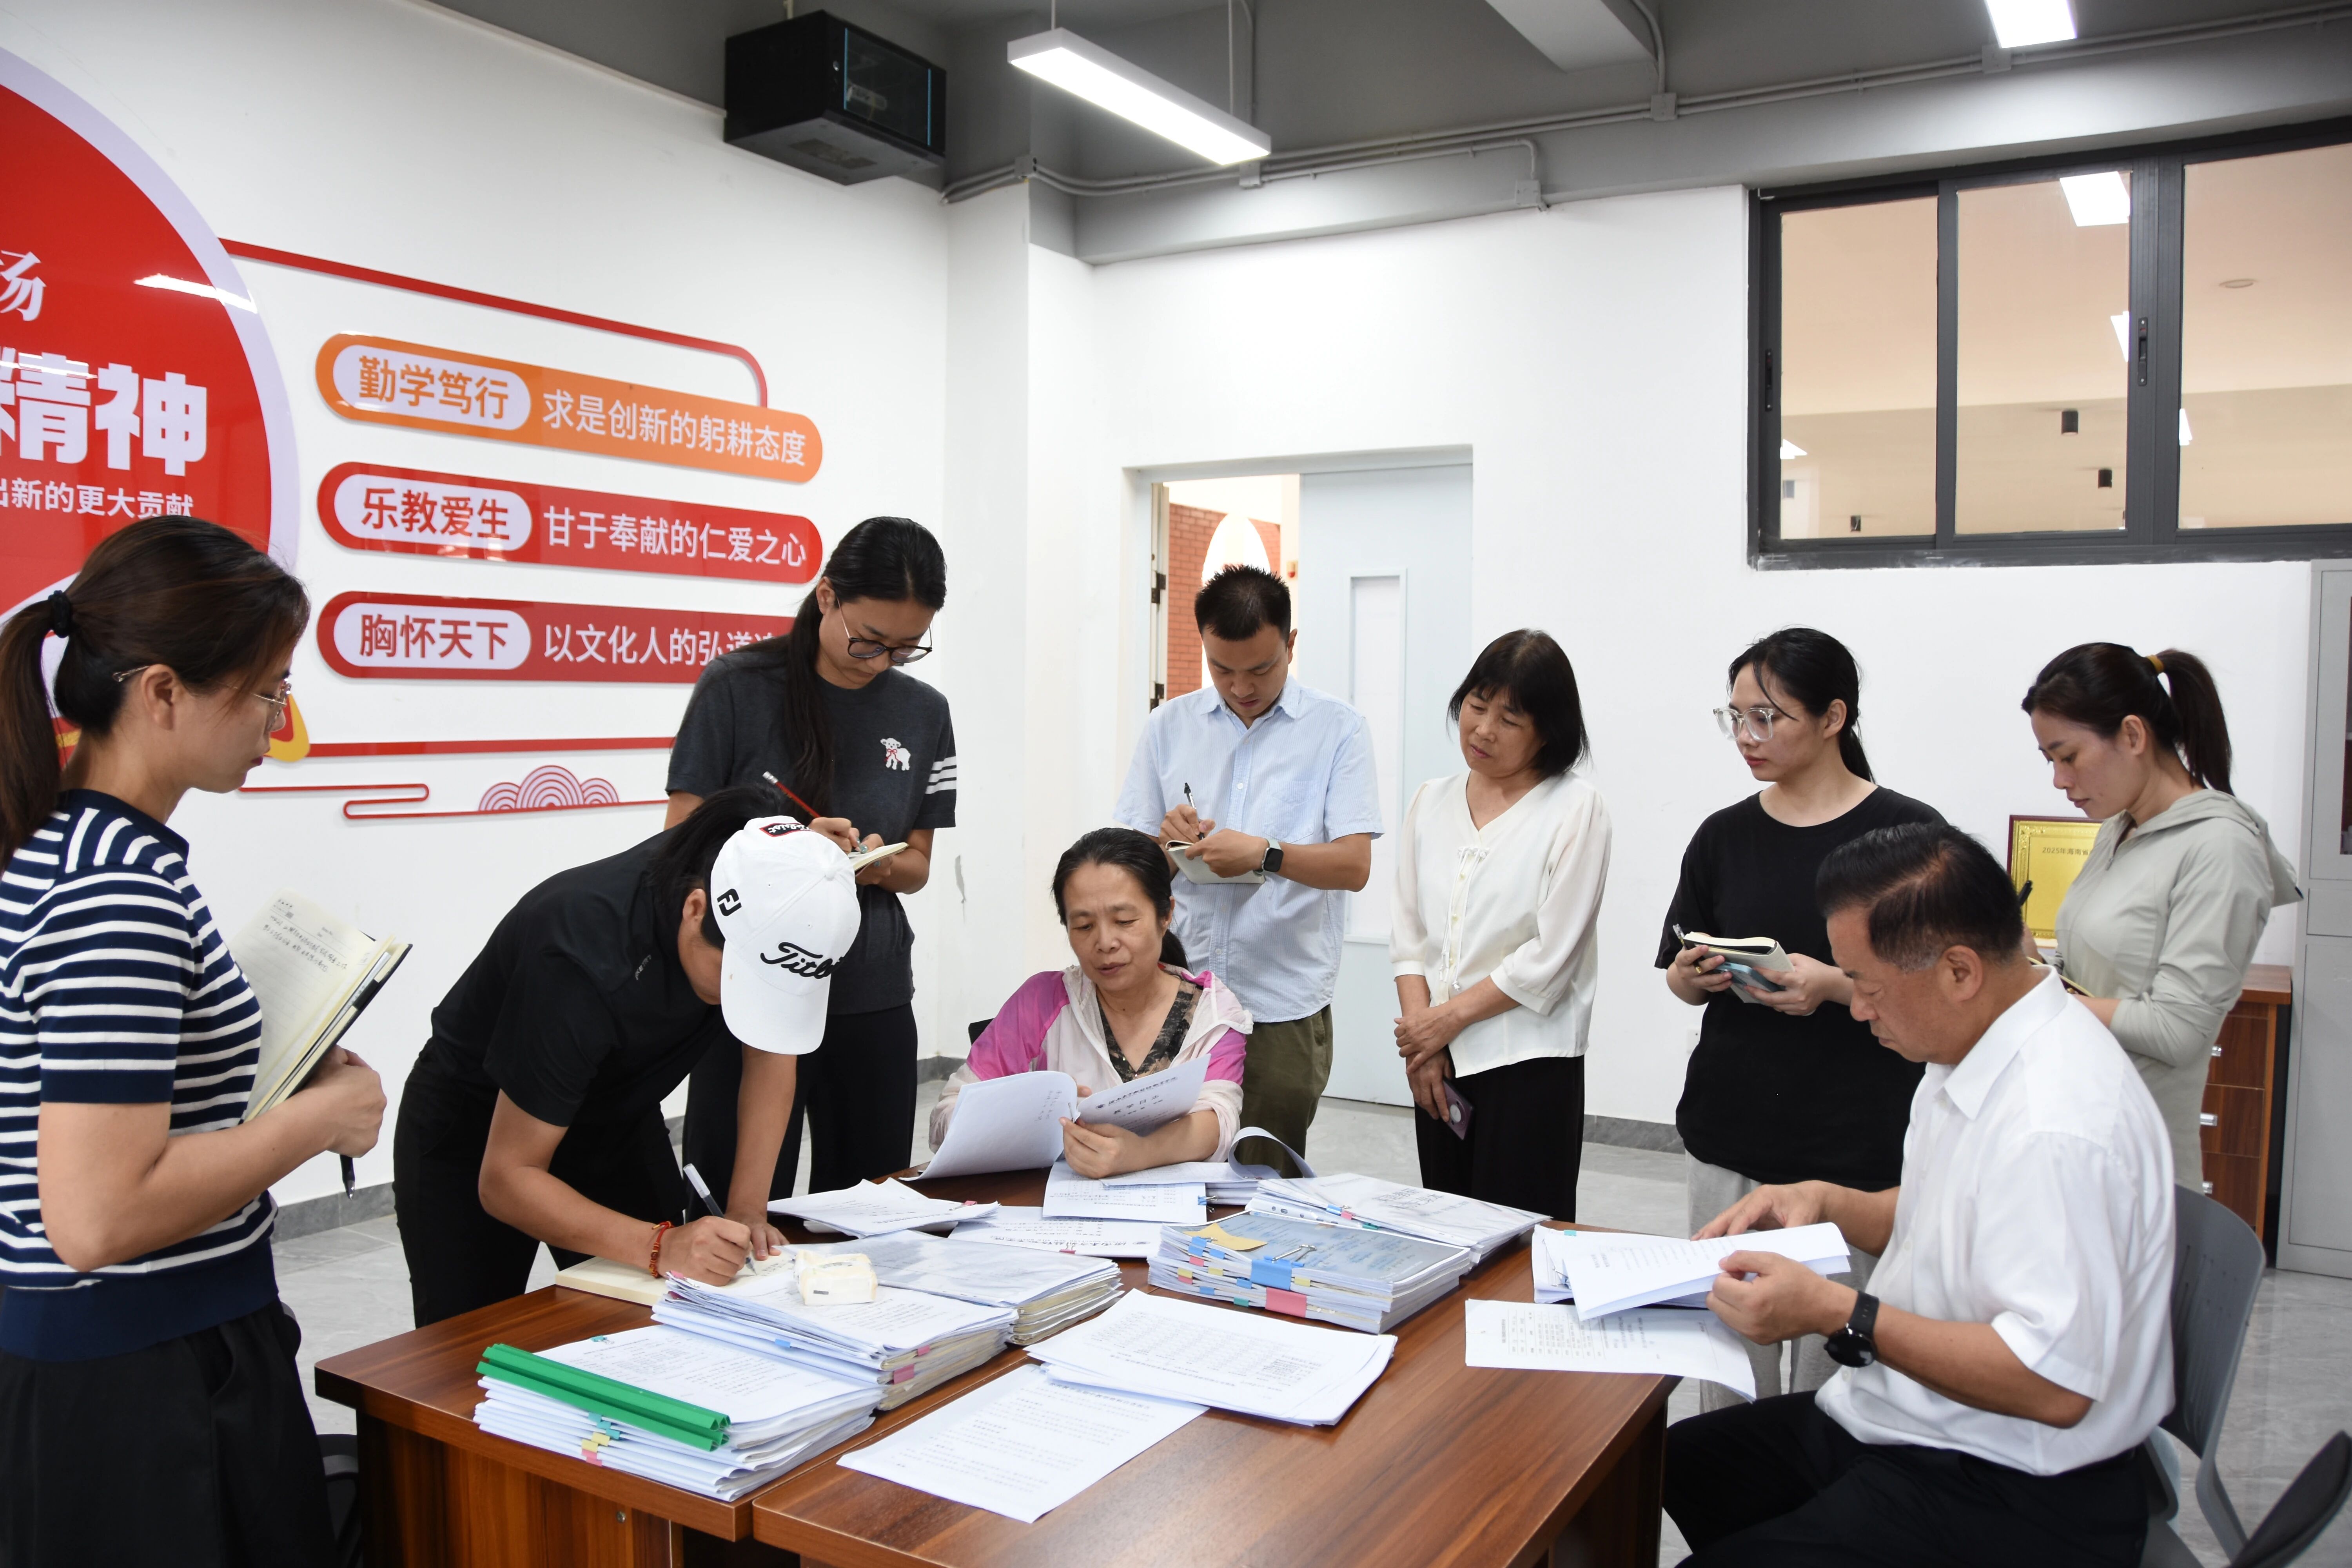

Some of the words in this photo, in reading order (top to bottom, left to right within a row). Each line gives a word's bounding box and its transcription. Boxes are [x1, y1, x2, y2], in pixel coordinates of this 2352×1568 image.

[0, 347, 207, 476] 精神
[359, 356, 508, 419] 勤学笃行
[543, 389, 806, 466] 求是创新的躬耕态度
[361, 488, 510, 541] 乐教爱生
[543, 505, 807, 568] 甘于奉献的仁爱之心
[359, 614, 508, 660] 胸怀天下
[2042, 847, 2089, 855] 2025年海南省
[717, 888, 742, 916] FJ
[760, 942, 845, 979] Titl
